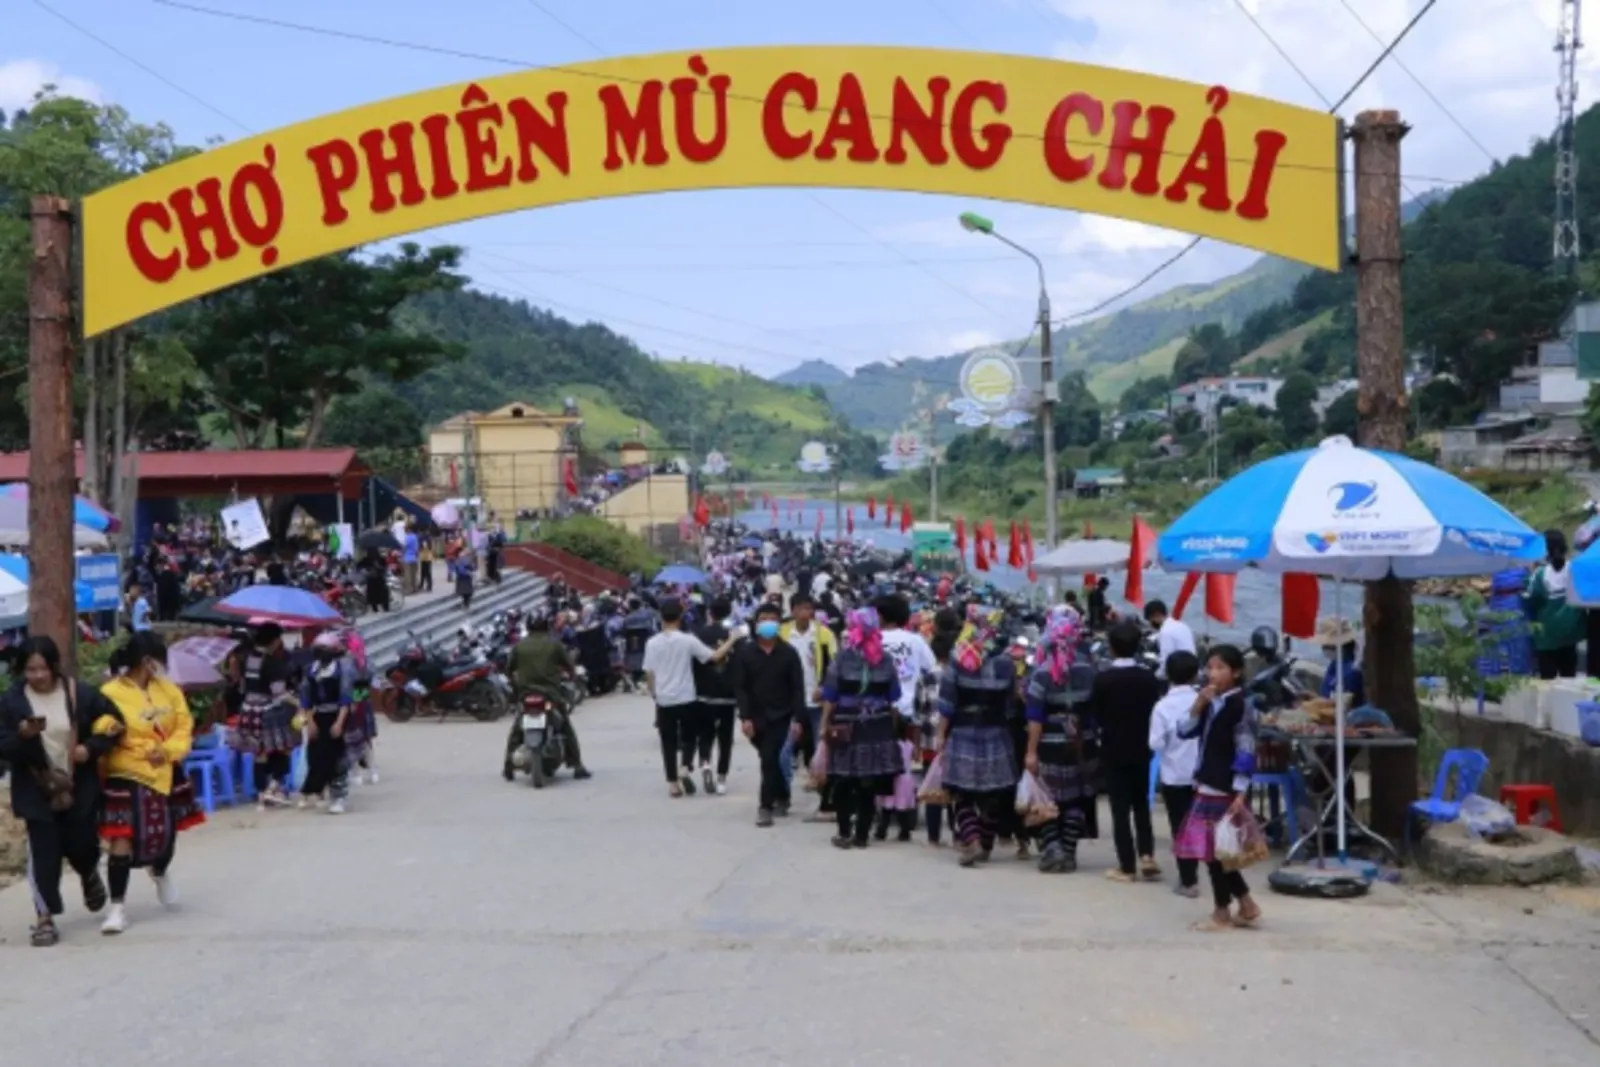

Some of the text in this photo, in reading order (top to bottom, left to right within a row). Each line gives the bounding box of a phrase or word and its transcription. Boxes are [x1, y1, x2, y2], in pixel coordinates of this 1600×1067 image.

[125, 54, 1288, 283] CHỢ PHIÊN MÙ CANG CHẢI
